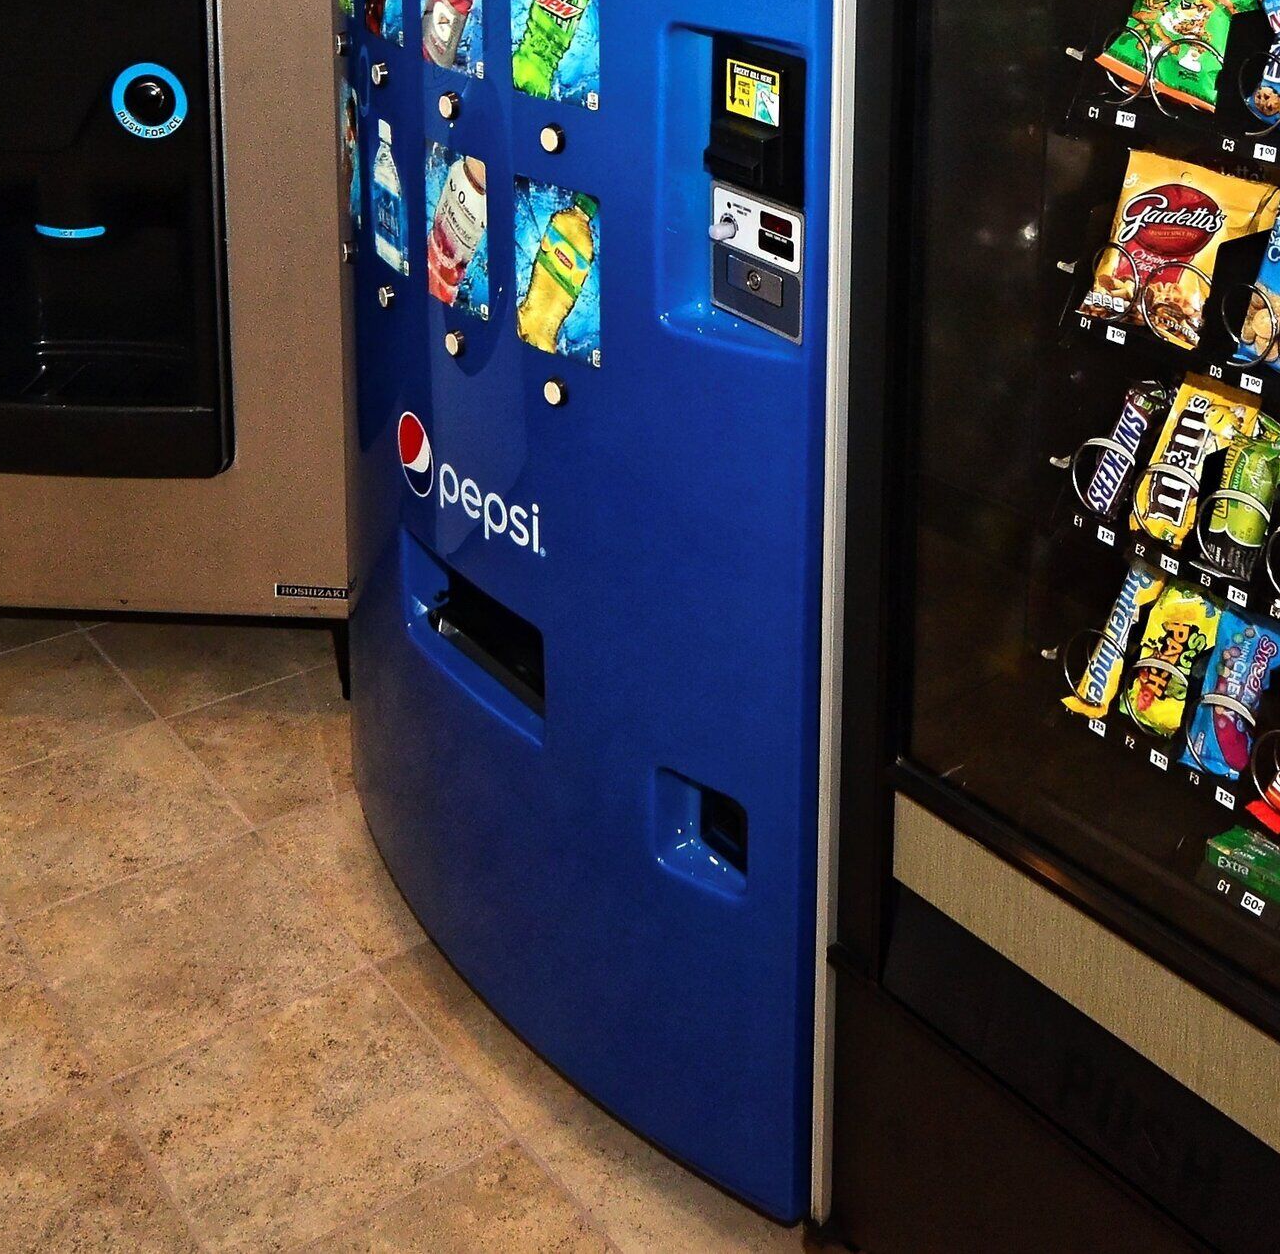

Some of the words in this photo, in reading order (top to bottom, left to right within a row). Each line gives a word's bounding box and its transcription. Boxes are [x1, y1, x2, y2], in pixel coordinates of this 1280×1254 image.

[117, 111, 142, 134] PUSH
[145, 127, 166, 137] FOR
[167, 116, 182, 131] ICE
[1118, 193, 1226, 244] Gardetto's
[1209, 365, 1223, 379] D3
[437, 463, 541, 554] pepsi
[1200, 573, 1212, 587] E3
[281, 586, 346, 598] HOSHIZAKI
[1189, 772, 1200, 785] F3
[1218, 856, 1250, 877] Extra
[1217, 879, 1231, 895] G1
